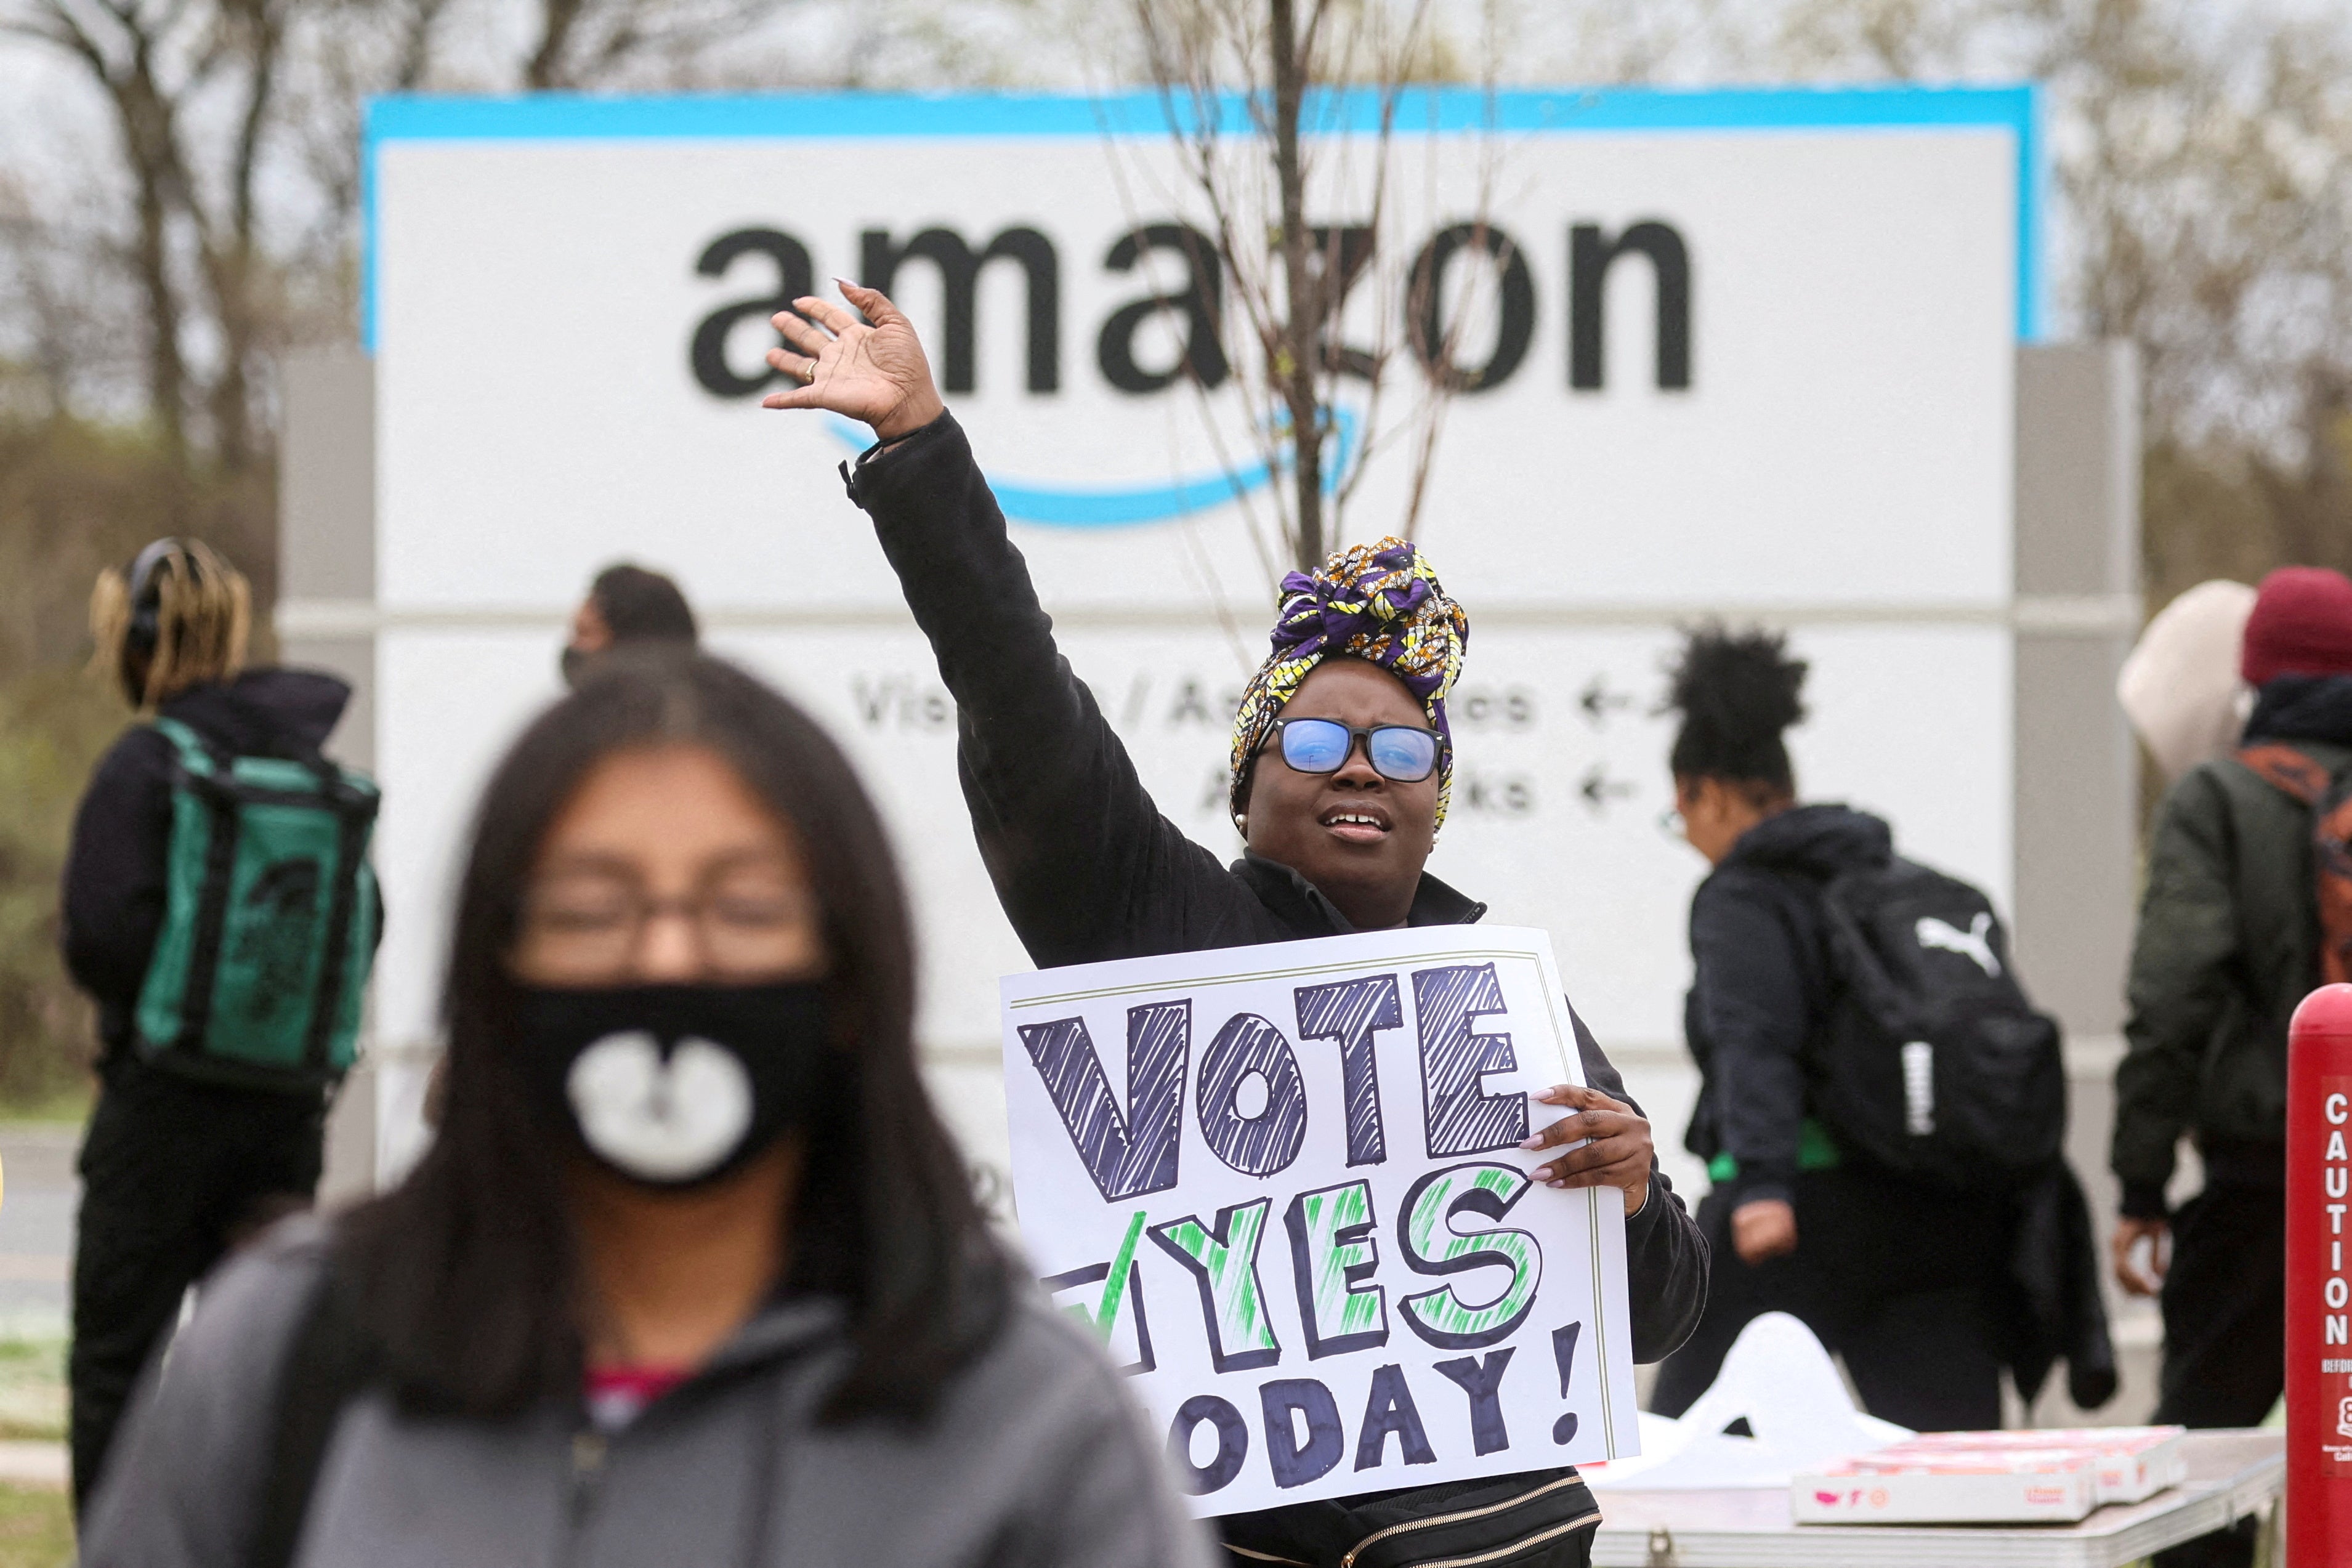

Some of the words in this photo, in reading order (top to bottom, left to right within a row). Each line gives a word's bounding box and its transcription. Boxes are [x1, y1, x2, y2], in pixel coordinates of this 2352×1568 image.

[689, 219, 1692, 399] amazon
[1017, 962, 1530, 1203] VOTE
[1146, 1161, 1544, 1374] YES
[2325, 1093, 2349, 1346] CAUTION
[1165, 1320, 1580, 1497] ODAY!
